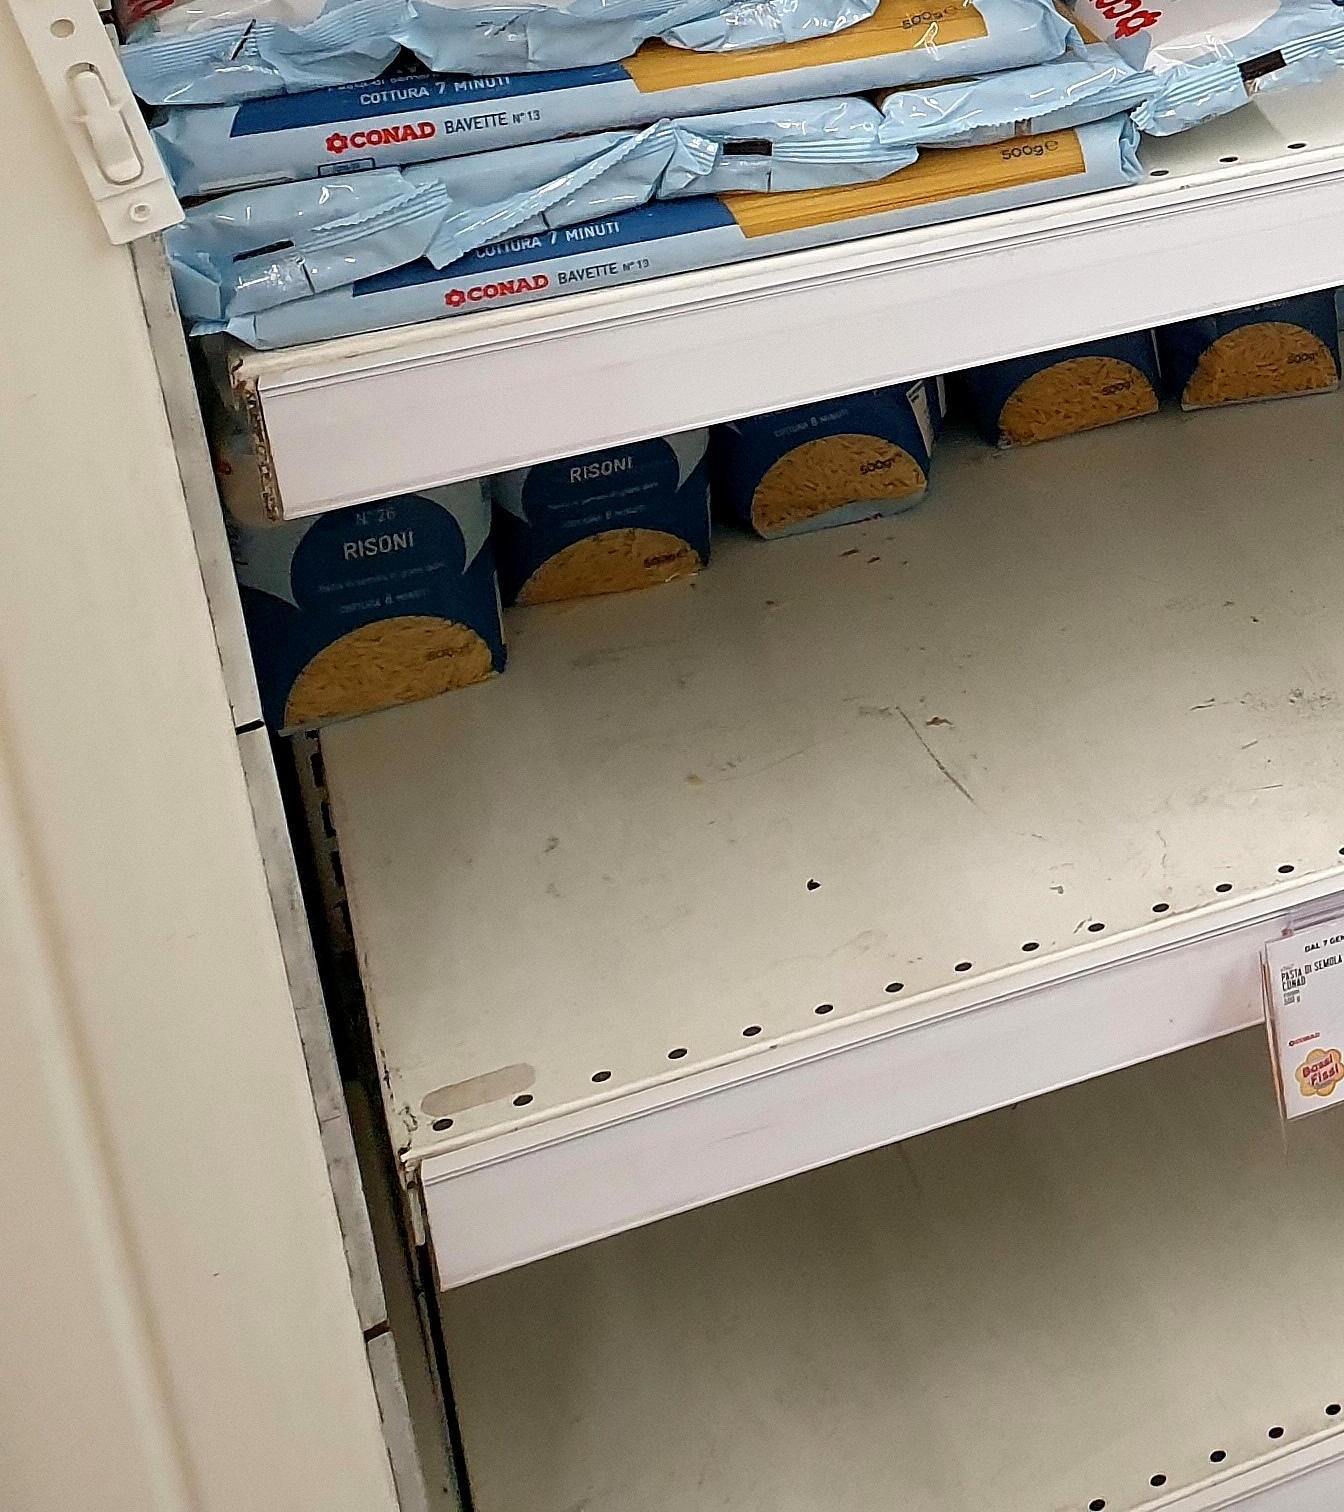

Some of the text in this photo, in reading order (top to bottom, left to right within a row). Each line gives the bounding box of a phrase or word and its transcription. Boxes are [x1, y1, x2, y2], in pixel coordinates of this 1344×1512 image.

[360, 86, 430, 105] COTTURA
[437, 81, 446, 95] 7
[453, 76, 510, 92] MINUTI
[350, 109, 541, 148] CONAD BAVETTE N° 13
[1001, 143, 1045, 161] 500g
[548, 231, 557, 245] 7
[565, 221, 621, 242] MINUTI
[466, 263, 620, 302] CONAD BAVETTE
[569, 456, 633, 483] RISONI
[343, 531, 414, 560] RISONI
[1304, 944, 1320, 953] DAL
[1281, 953, 1343, 983] PASTA SEMOLA
[1282, 975, 1306, 991] CONAD
